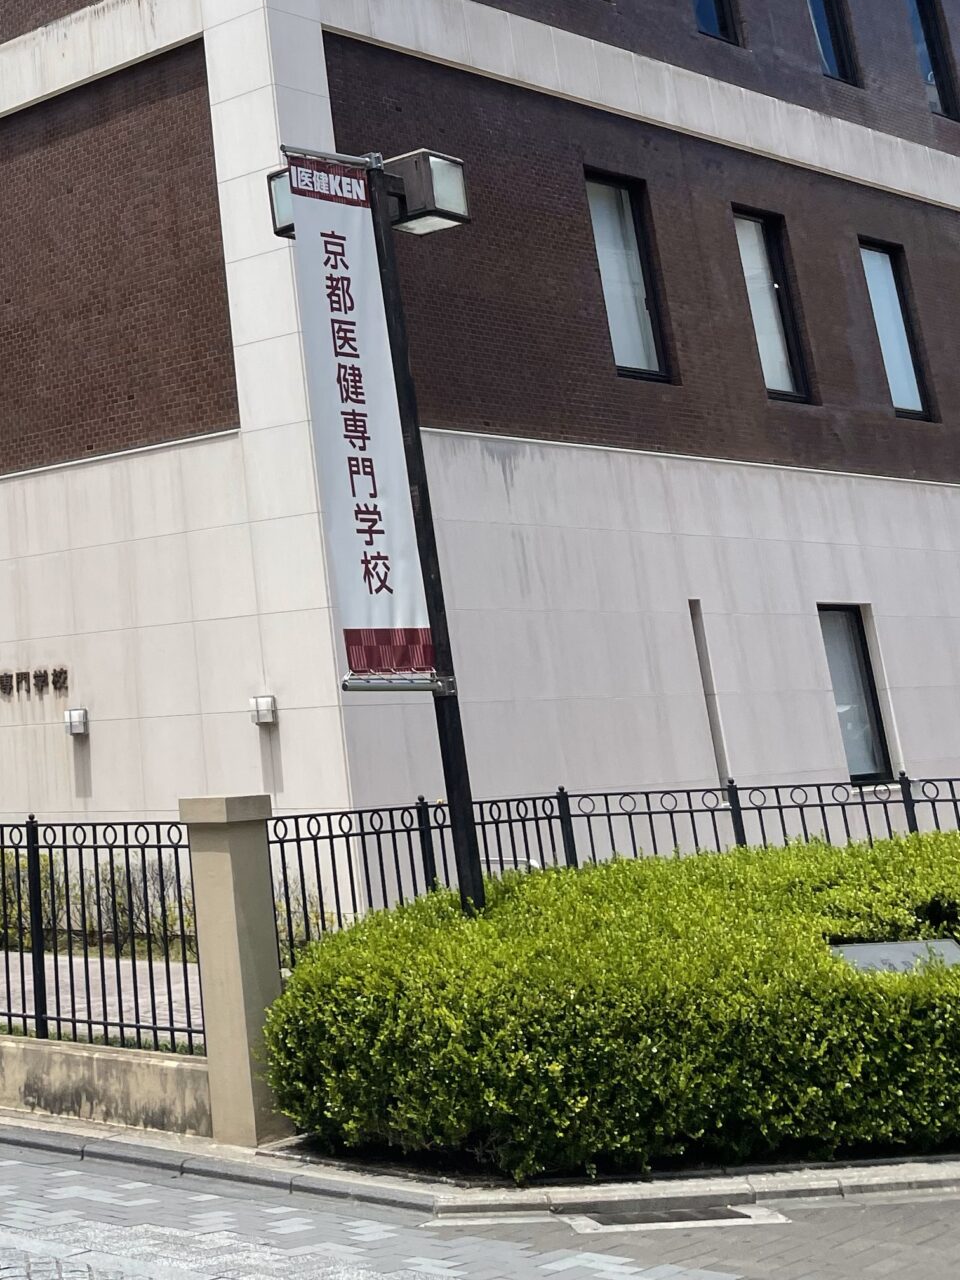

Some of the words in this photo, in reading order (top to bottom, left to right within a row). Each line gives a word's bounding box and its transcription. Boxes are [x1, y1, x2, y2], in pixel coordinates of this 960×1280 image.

[320, 230, 394, 595] 京都医健専門学校
